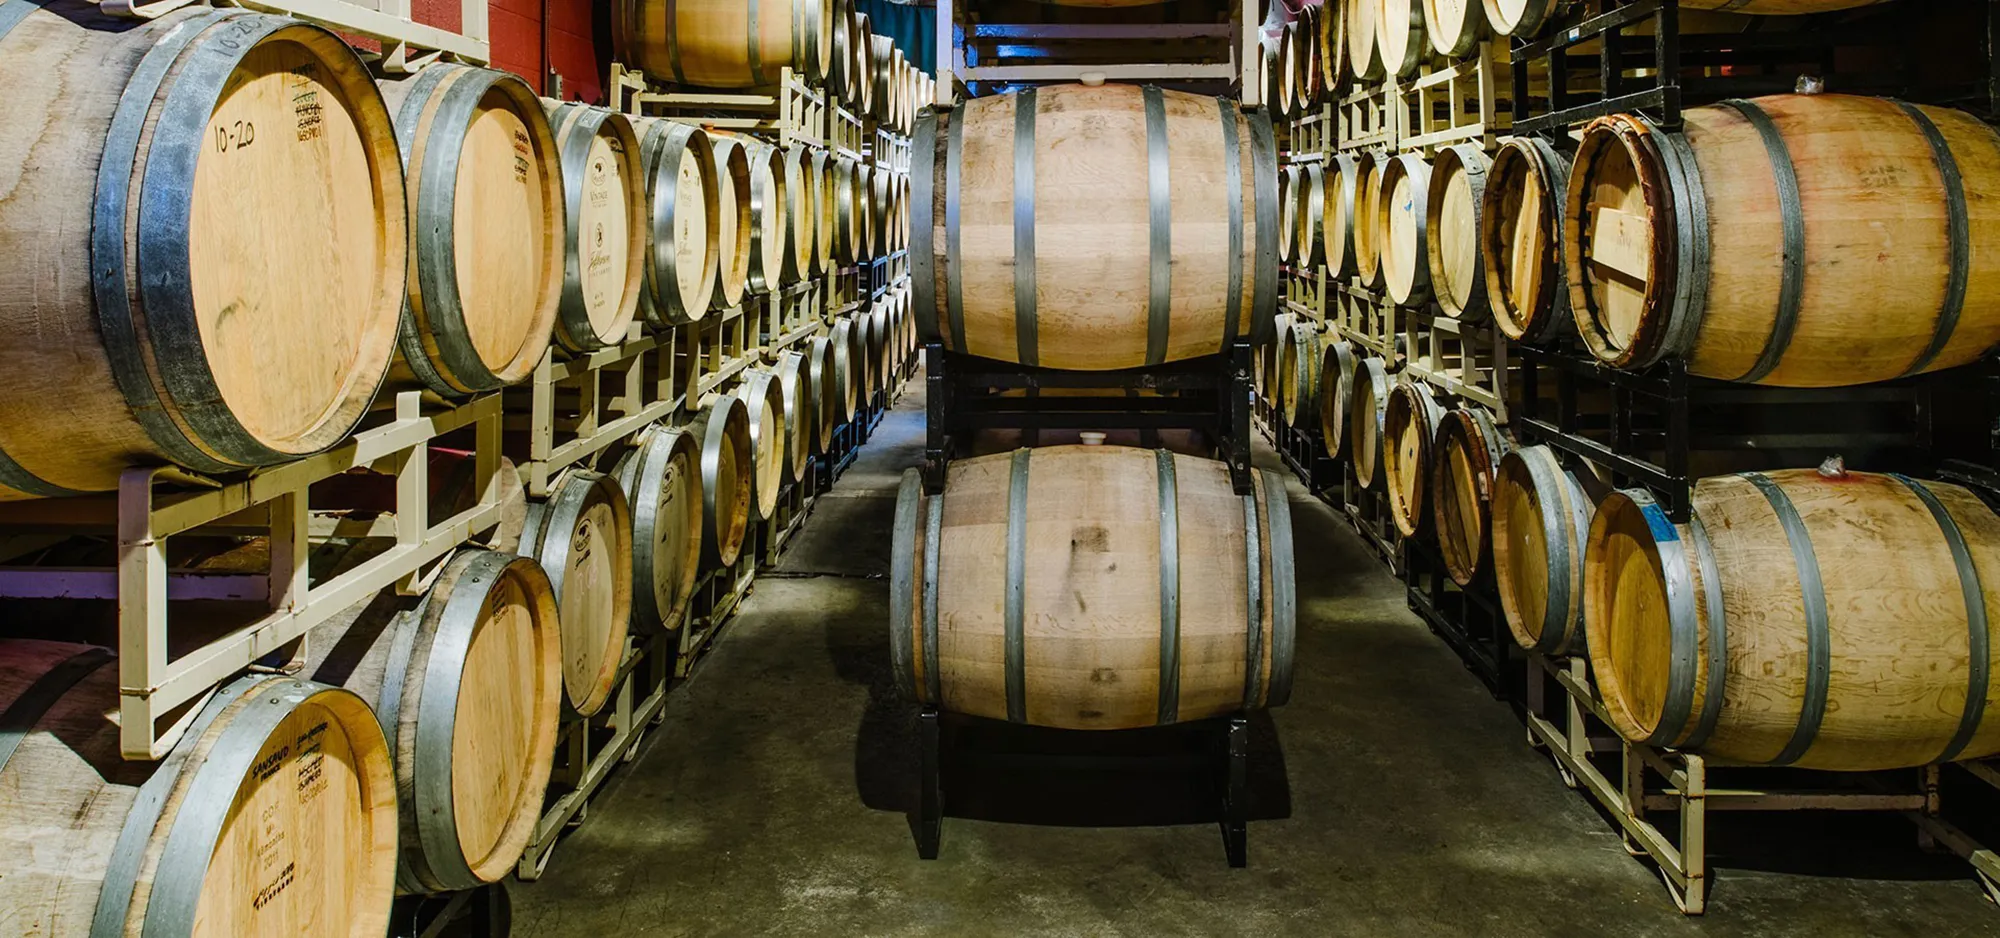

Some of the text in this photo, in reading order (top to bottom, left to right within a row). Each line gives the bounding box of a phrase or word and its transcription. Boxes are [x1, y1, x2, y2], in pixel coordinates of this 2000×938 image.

[214, 120, 255, 153] 10-20
[252, 745, 289, 779] SANSAUD
[261, 762, 281, 782] FRANCE
